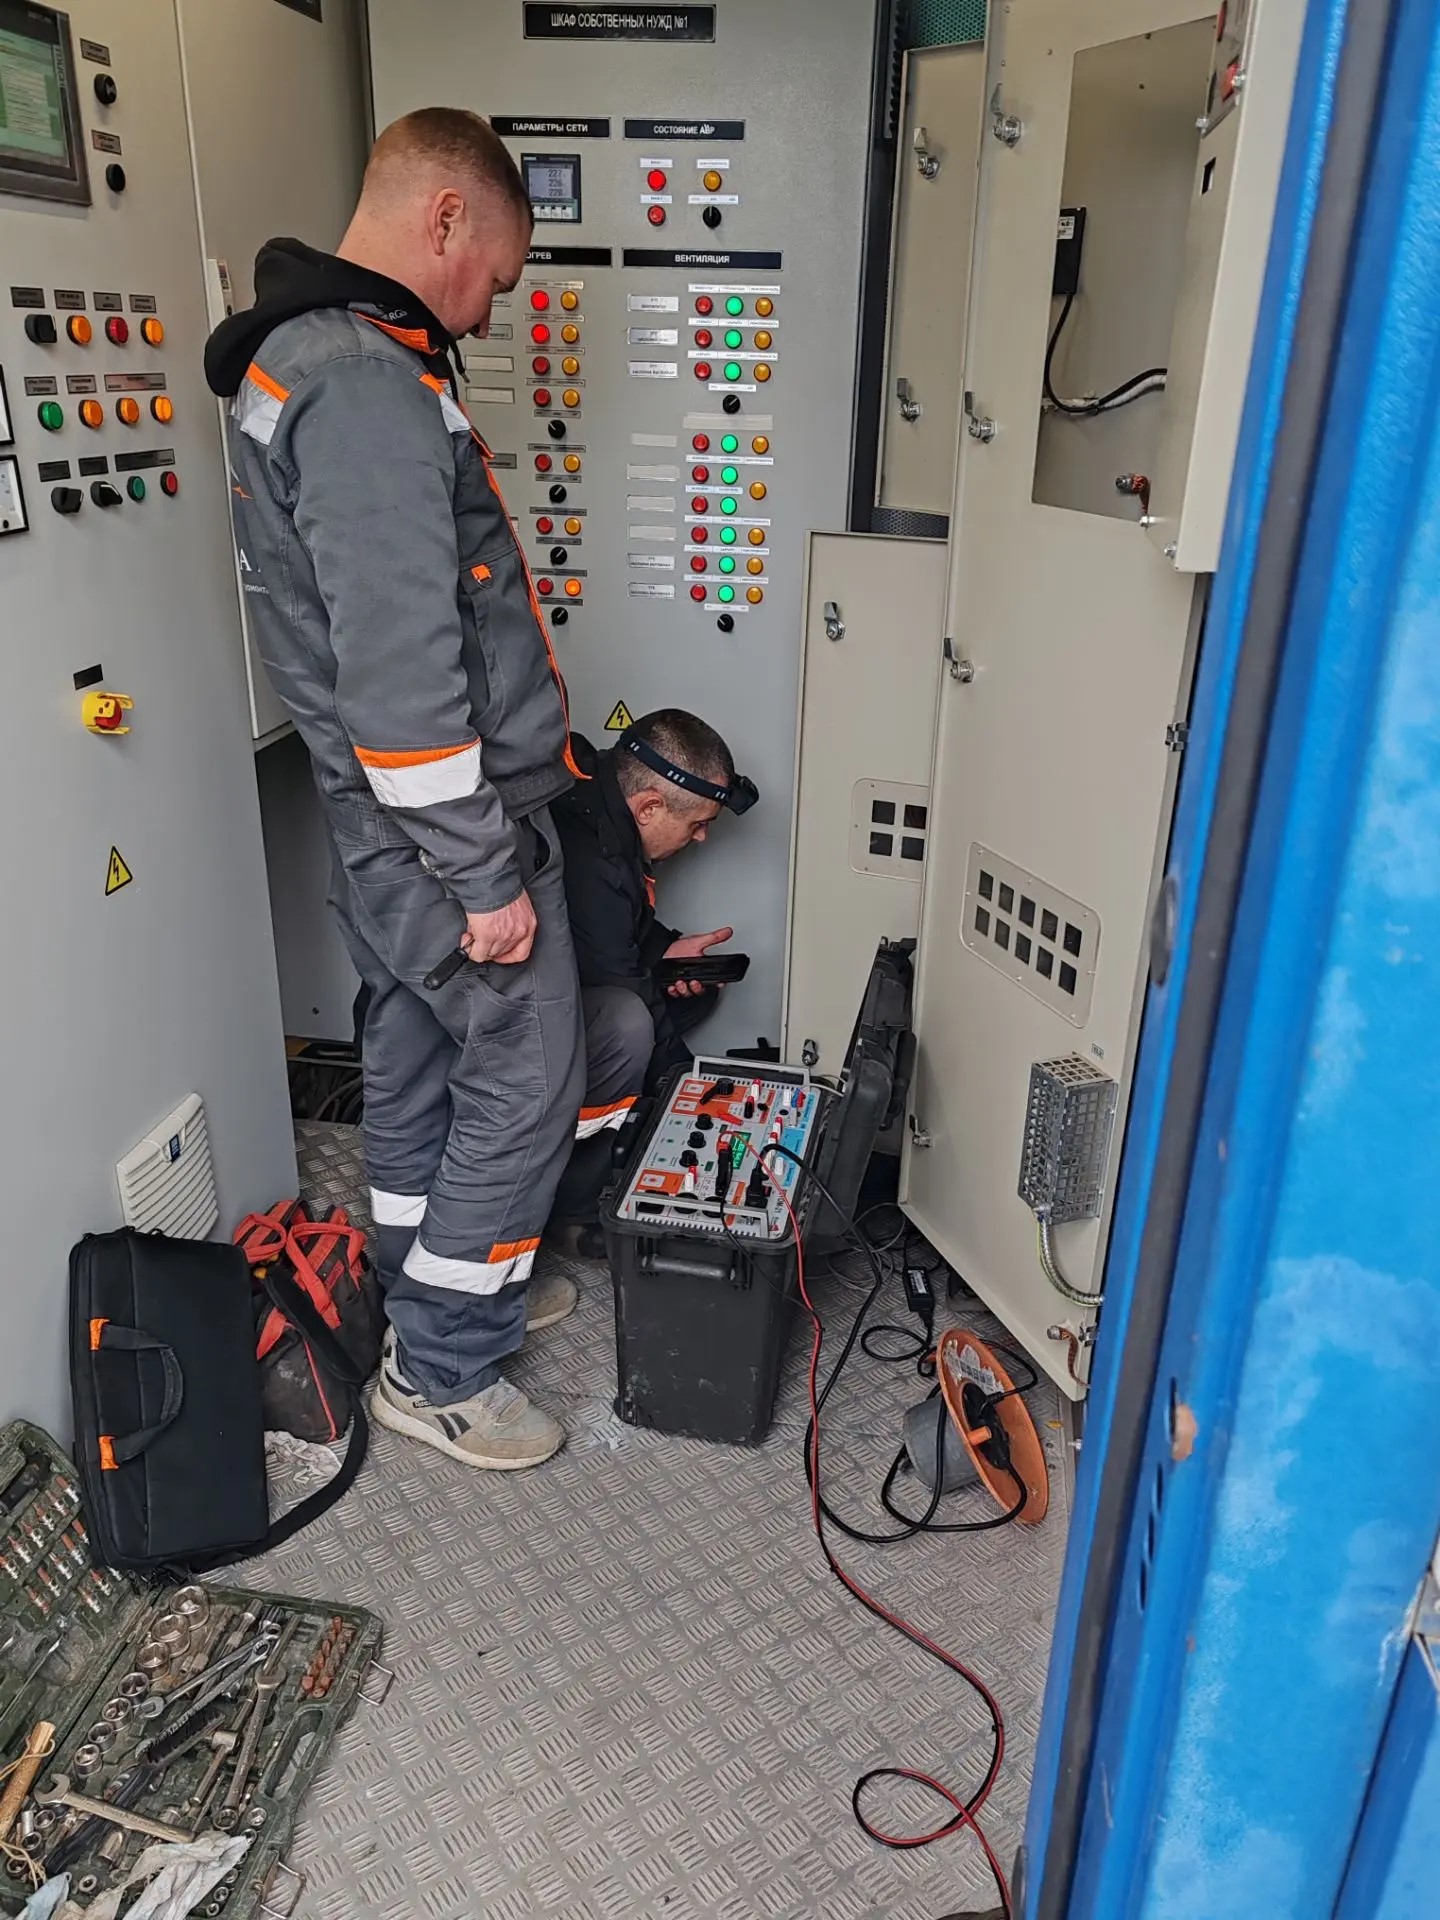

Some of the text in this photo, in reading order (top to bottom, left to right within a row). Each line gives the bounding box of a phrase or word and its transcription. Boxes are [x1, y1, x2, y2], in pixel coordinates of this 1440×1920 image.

[551, 13, 689, 31] ШКАФ СОБСТВЕННЫХ НУЖД №1
[512, 123, 588, 132] ПАРАМЕТРЫ СЕТИ
[653, 125, 698, 134] СОСТОЯНИЕ
[525, 251, 553, 260] ОГРЕВ
[674, 254, 730, 264] ВЕНТИЛЯЦИЯ
